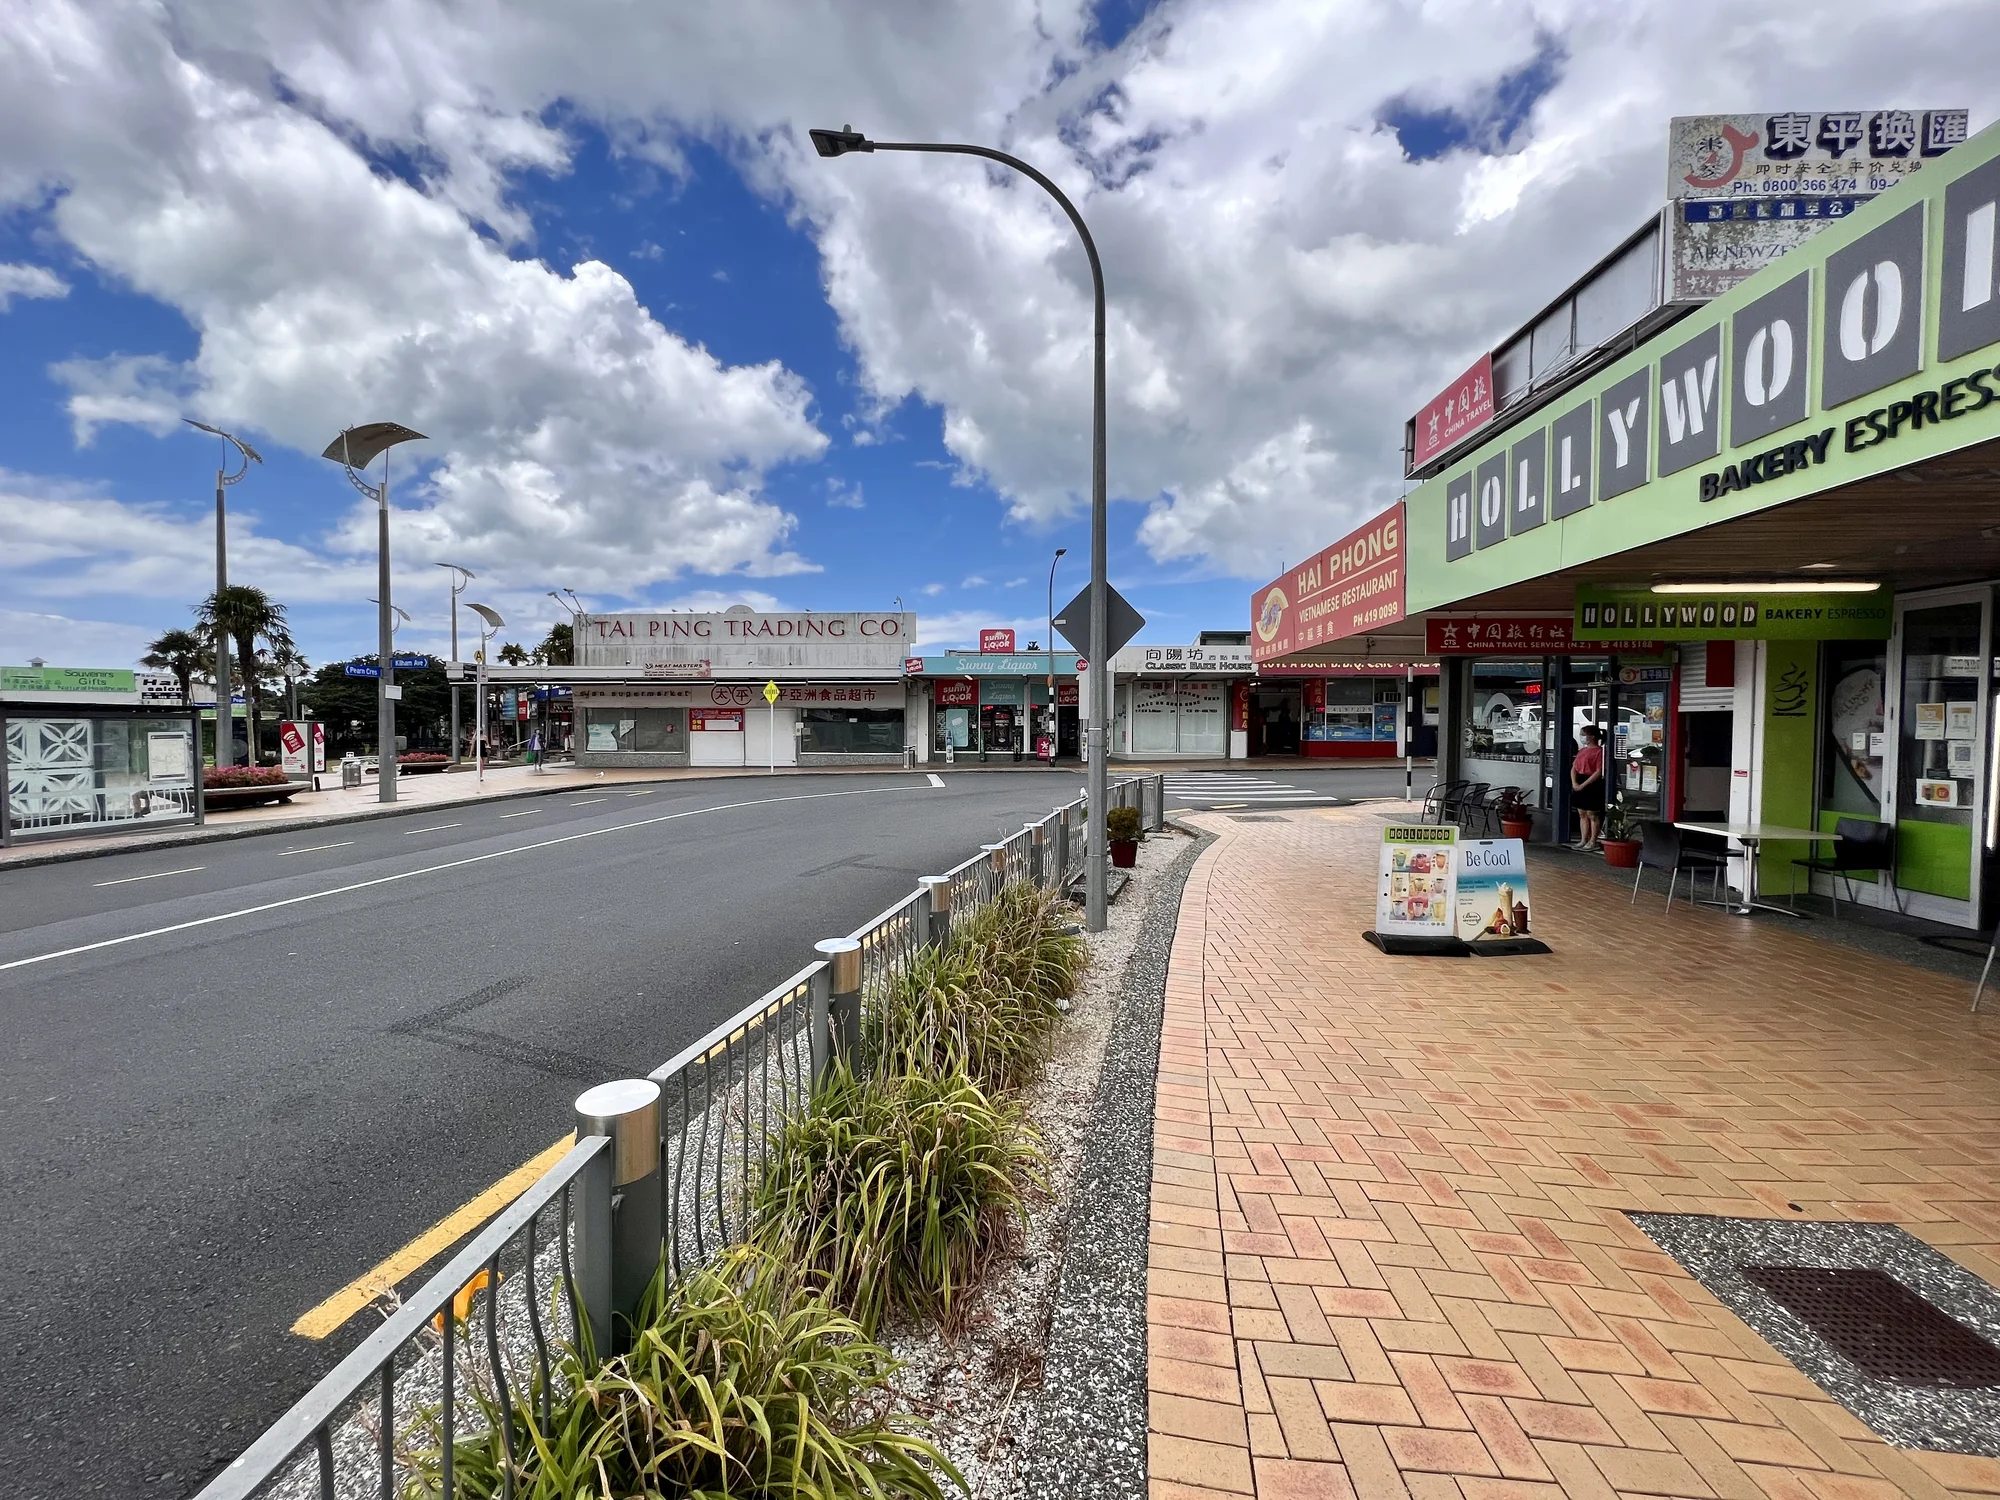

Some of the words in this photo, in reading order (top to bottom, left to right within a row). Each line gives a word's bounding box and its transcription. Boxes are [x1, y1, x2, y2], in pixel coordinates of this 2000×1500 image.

[1733, 181, 1758, 194] Ph:
[1762, 179, 1798, 193] 0800
[1801, 179, 1827, 191] 366
[1830, 178, 1857, 191] 474
[1869, 178, 1900, 191] 09-
[1444, 418, 1465, 438] CHINA
[1466, 402, 1492, 421] TRAVEL
[1700, 427, 1836, 502] BAKERY
[1297, 563, 1322, 596] HAI
[1329, 518, 1398, 581] PHONG
[1298, 594, 1340, 624] VIETNAMESE
[1341, 568, 1398, 608] RESTAURANT
[1353, 614, 1363, 628] PH
[1364, 607, 1378, 624] 419
[1378, 601, 1398, 621] 0099
[1583, 604, 1757, 625] HOLLYWOOD
[1765, 608, 1824, 620] BAKERY
[1827, 608, 1886, 620] ESPRESSO
[594, 619, 634, 638] TAI
[648, 619, 711, 638] PING
[724, 619, 845, 638] TRADING
[1467, 641, 1495, 649] CHINA
[1496, 641, 1529, 649] TRAVEL
[1530, 641, 1565, 649] SERVICE
[413, 659, 424, 667] Ave
[956, 658, 994, 673] Sunny
[997, 658, 1039, 673] Liquor
[1145, 661, 1187, 670] CLASSIC
[1189, 661, 1216, 670] BAKE
[1218, 661, 1253, 670] HOUSE
[64, 669, 115, 679] Souvenirs
[366, 668, 378, 676] Cres
[78, 677, 107, 686] Gifts
[1389, 828, 1450, 841] HOLLYWOOD
[1465, 850, 1481, 867] Be
[1483, 849, 1511, 867] Cool
